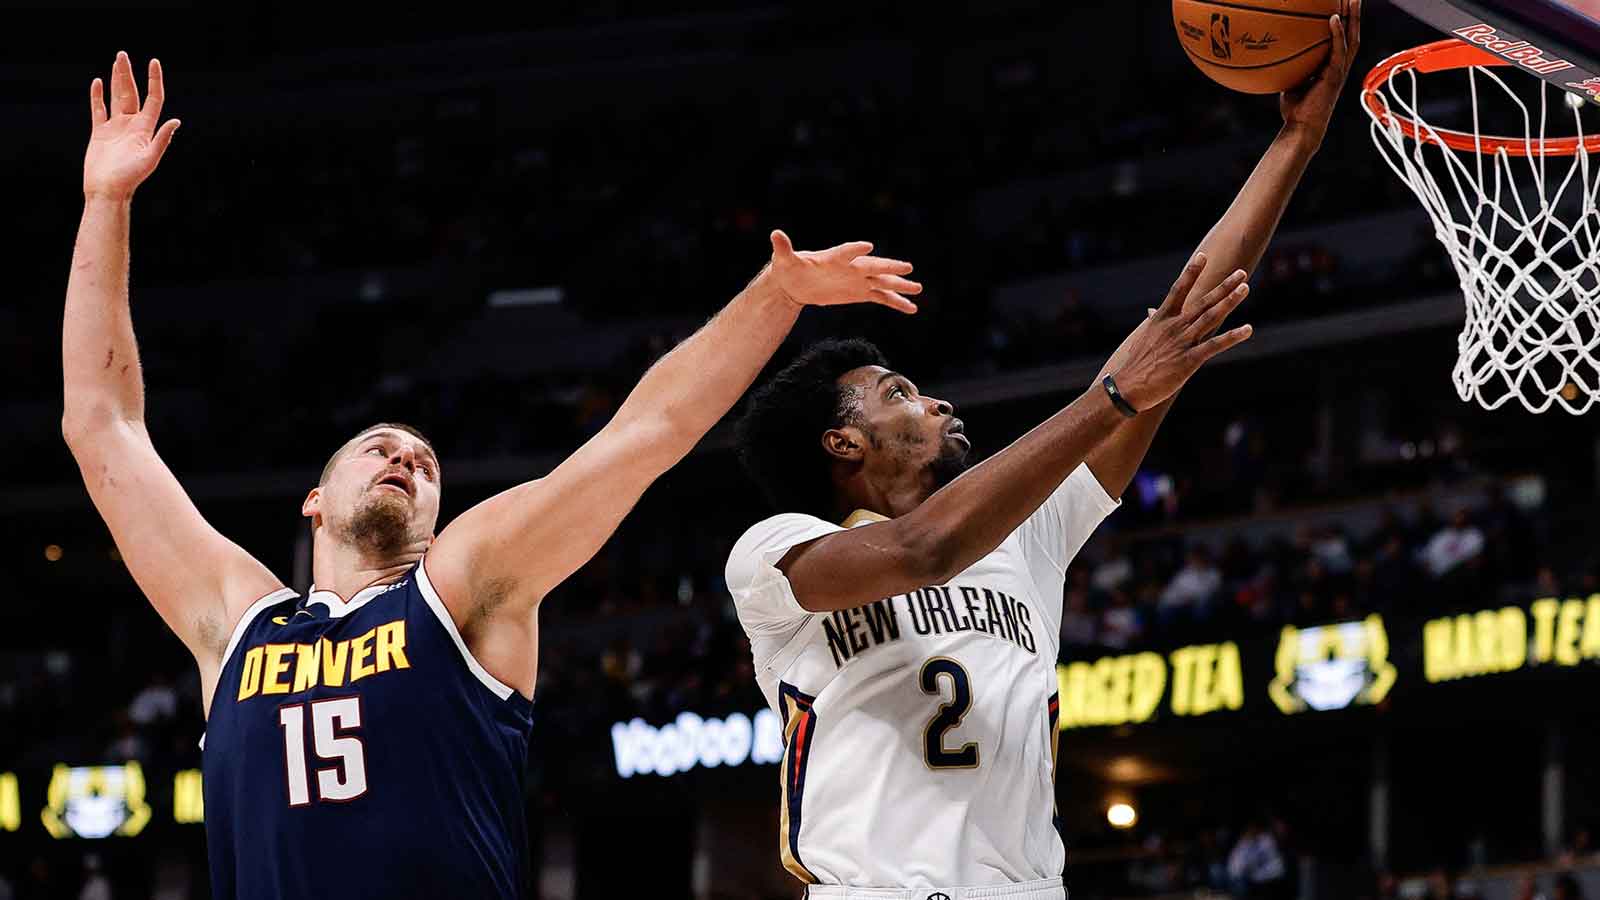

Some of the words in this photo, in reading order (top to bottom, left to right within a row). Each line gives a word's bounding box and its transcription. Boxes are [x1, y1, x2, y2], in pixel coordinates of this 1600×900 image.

[236, 618, 412, 704] DENVER
[821, 597, 900, 669] NEW
[906, 585, 1039, 654] ORLEANS
[1424, 606, 1527, 684] HARD
[919, 655, 981, 770] 2
[1170, 641, 1244, 716] TEA
[278, 695, 369, 807] 15
